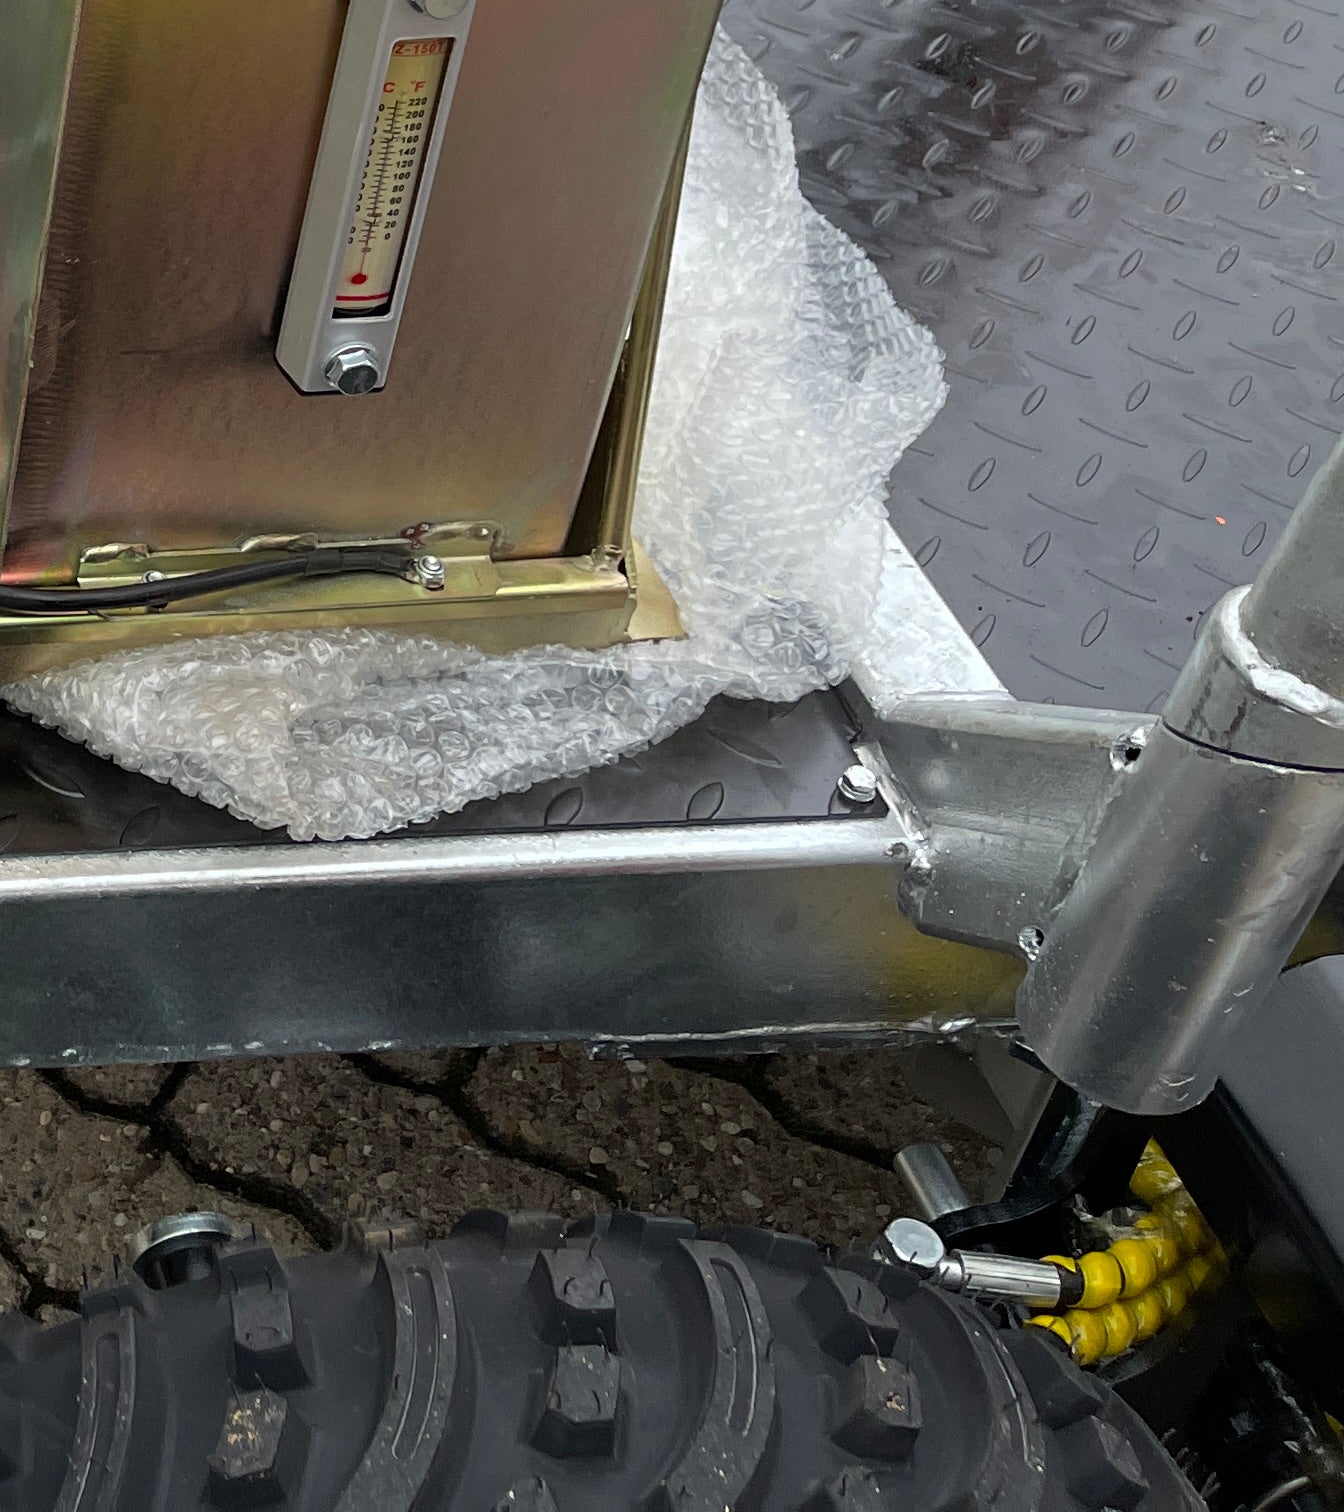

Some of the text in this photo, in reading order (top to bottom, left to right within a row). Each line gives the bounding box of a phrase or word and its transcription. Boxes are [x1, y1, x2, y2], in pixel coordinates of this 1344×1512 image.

[408, 97, 428, 106] 220
[405, 110, 425, 119] 200
[404, 123, 422, 131] 180
[401, 136, 419, 144] 160
[398, 148, 416, 156] 140
[395, 160, 413, 168] 120
[393, 172, 410, 180] 100
[392, 185, 405, 193] 80
[389, 197, 402, 205] 60
[384, 221, 397, 229] 20
